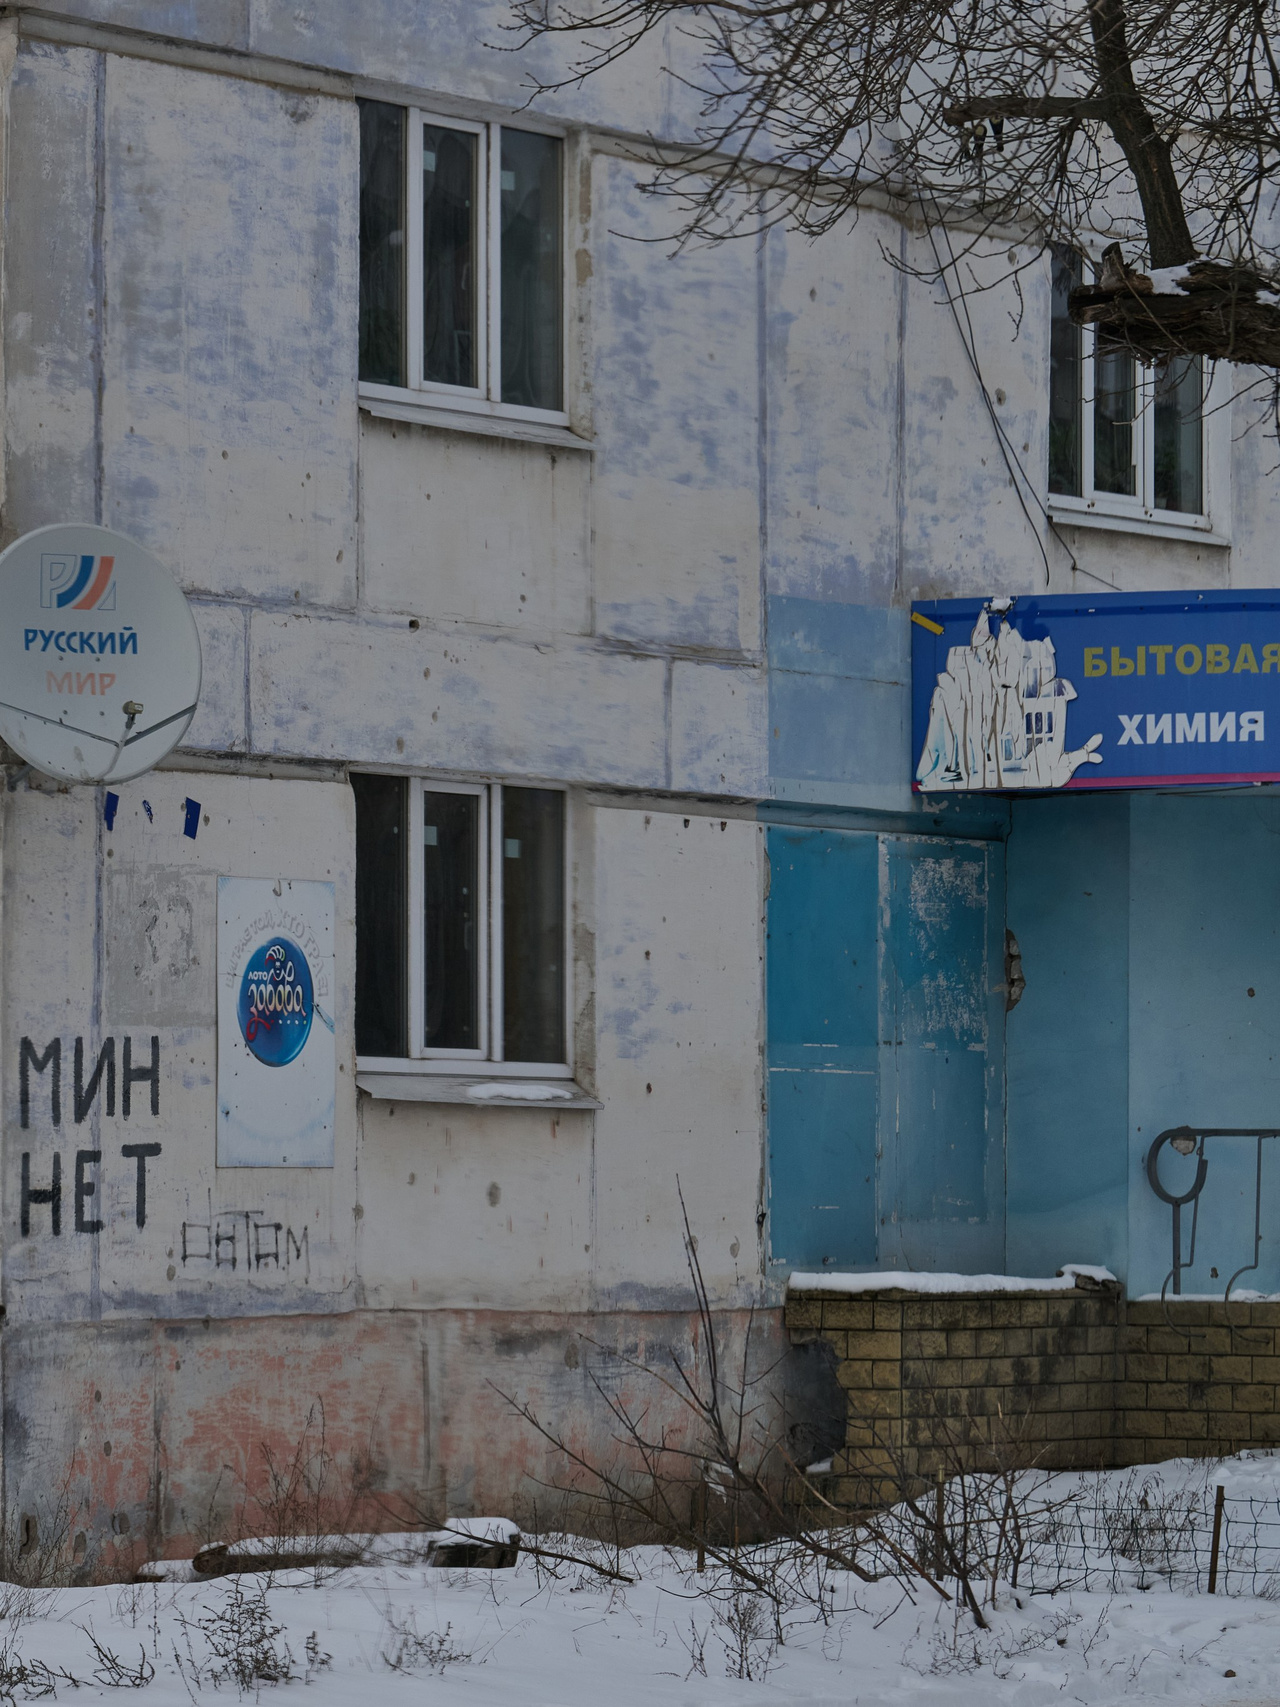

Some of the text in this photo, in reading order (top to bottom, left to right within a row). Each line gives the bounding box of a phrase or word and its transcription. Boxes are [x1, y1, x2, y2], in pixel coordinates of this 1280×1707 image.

[23, 626, 138, 655] РУССКИЙ
[1083, 643, 1280, 678] БЫТОВАЯ
[45, 670, 116, 696] МИР
[1117, 711, 1265, 746] ХИМИЯ
[248, 970, 268, 981] ЛОТО
[20, 1035, 161, 1129] МИН
[20, 1141, 162, 1238] НЕТ
